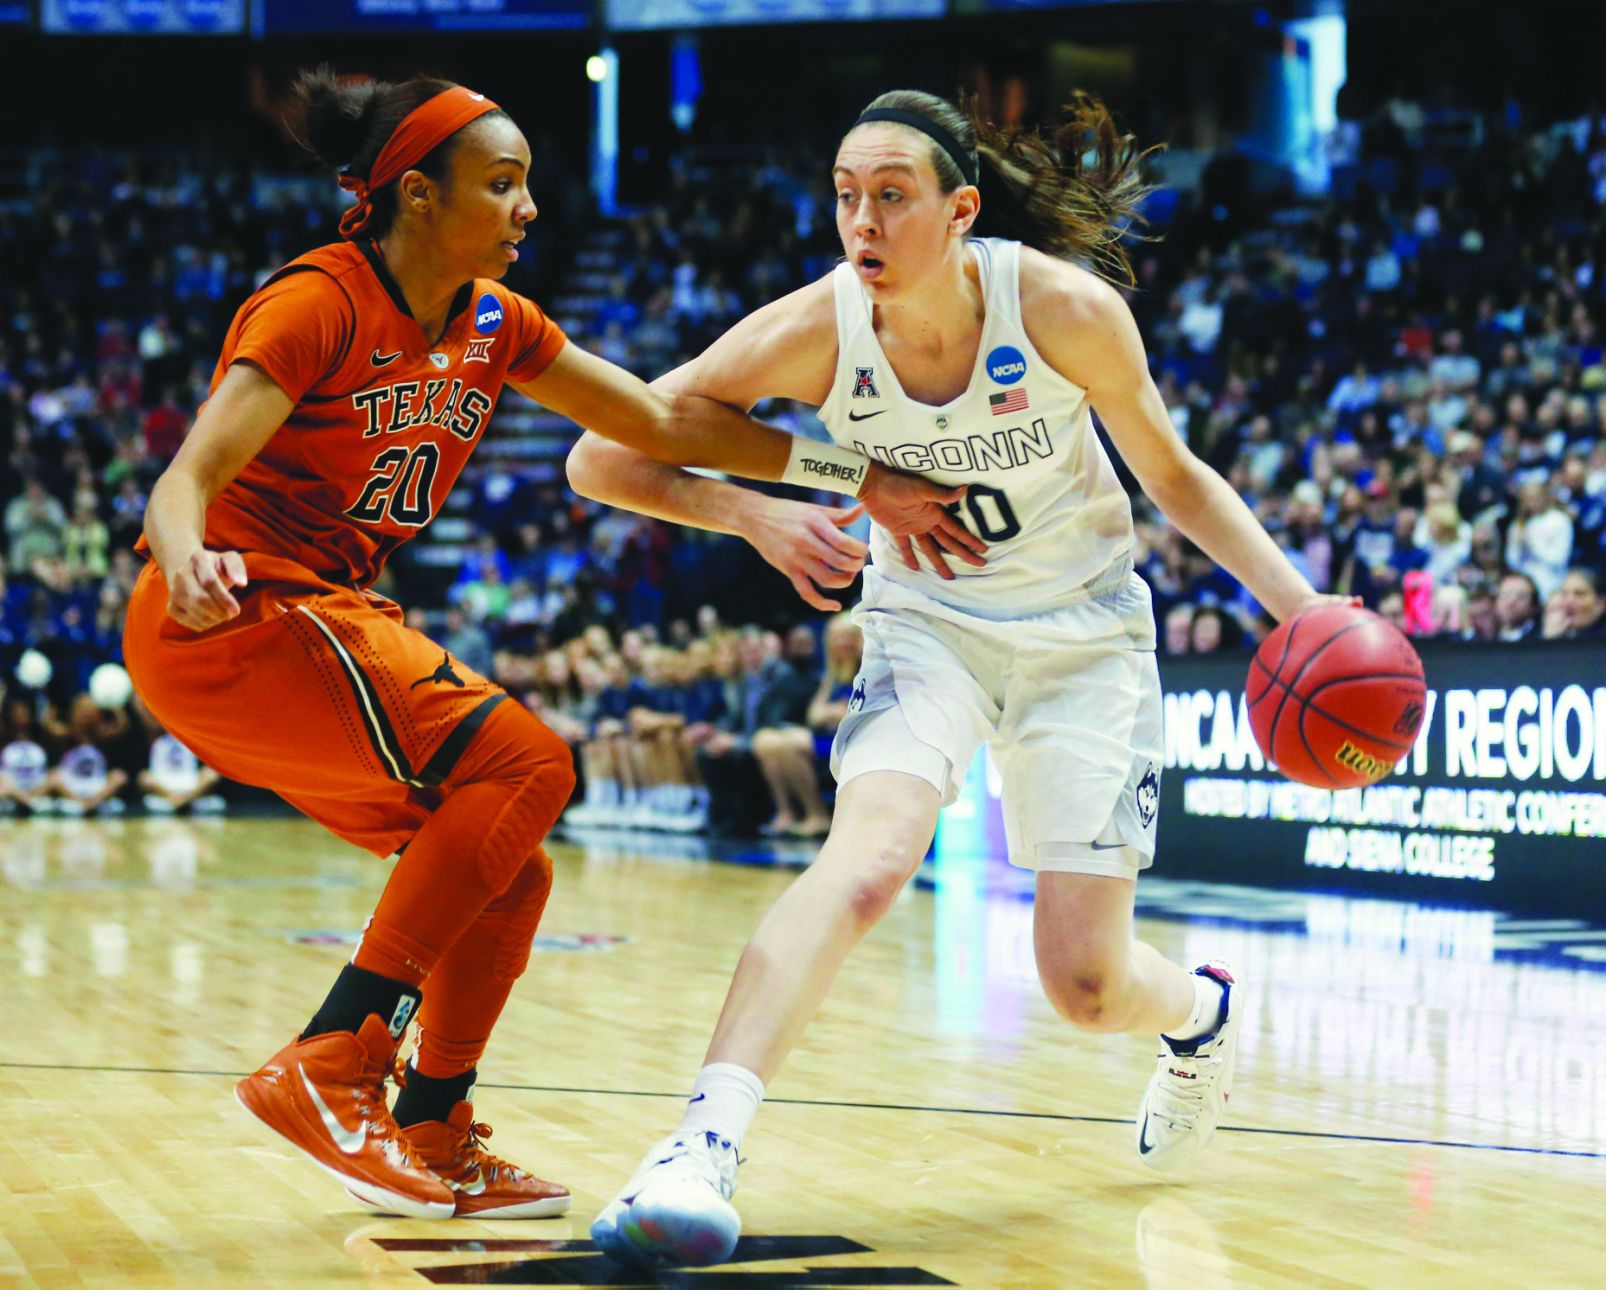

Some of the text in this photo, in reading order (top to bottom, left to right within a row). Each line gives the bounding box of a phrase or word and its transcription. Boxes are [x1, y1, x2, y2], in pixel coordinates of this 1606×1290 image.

[477, 309, 502, 326] NCAA
[992, 362, 1025, 378] NCAA
[352, 378, 492, 442] TEXAS
[800, 458, 864, 485] TOGETHER!
[853, 417, 1054, 473] UCONN
[342, 441, 440, 527] 20
[1163, 689, 1264, 772] NCAA
[1330, 785, 1421, 828] ATLANTIC
[1420, 786, 1516, 834] ATHLETIC
[1304, 826, 1348, 869] AND
[1403, 832, 1495, 881] COLLEGE
